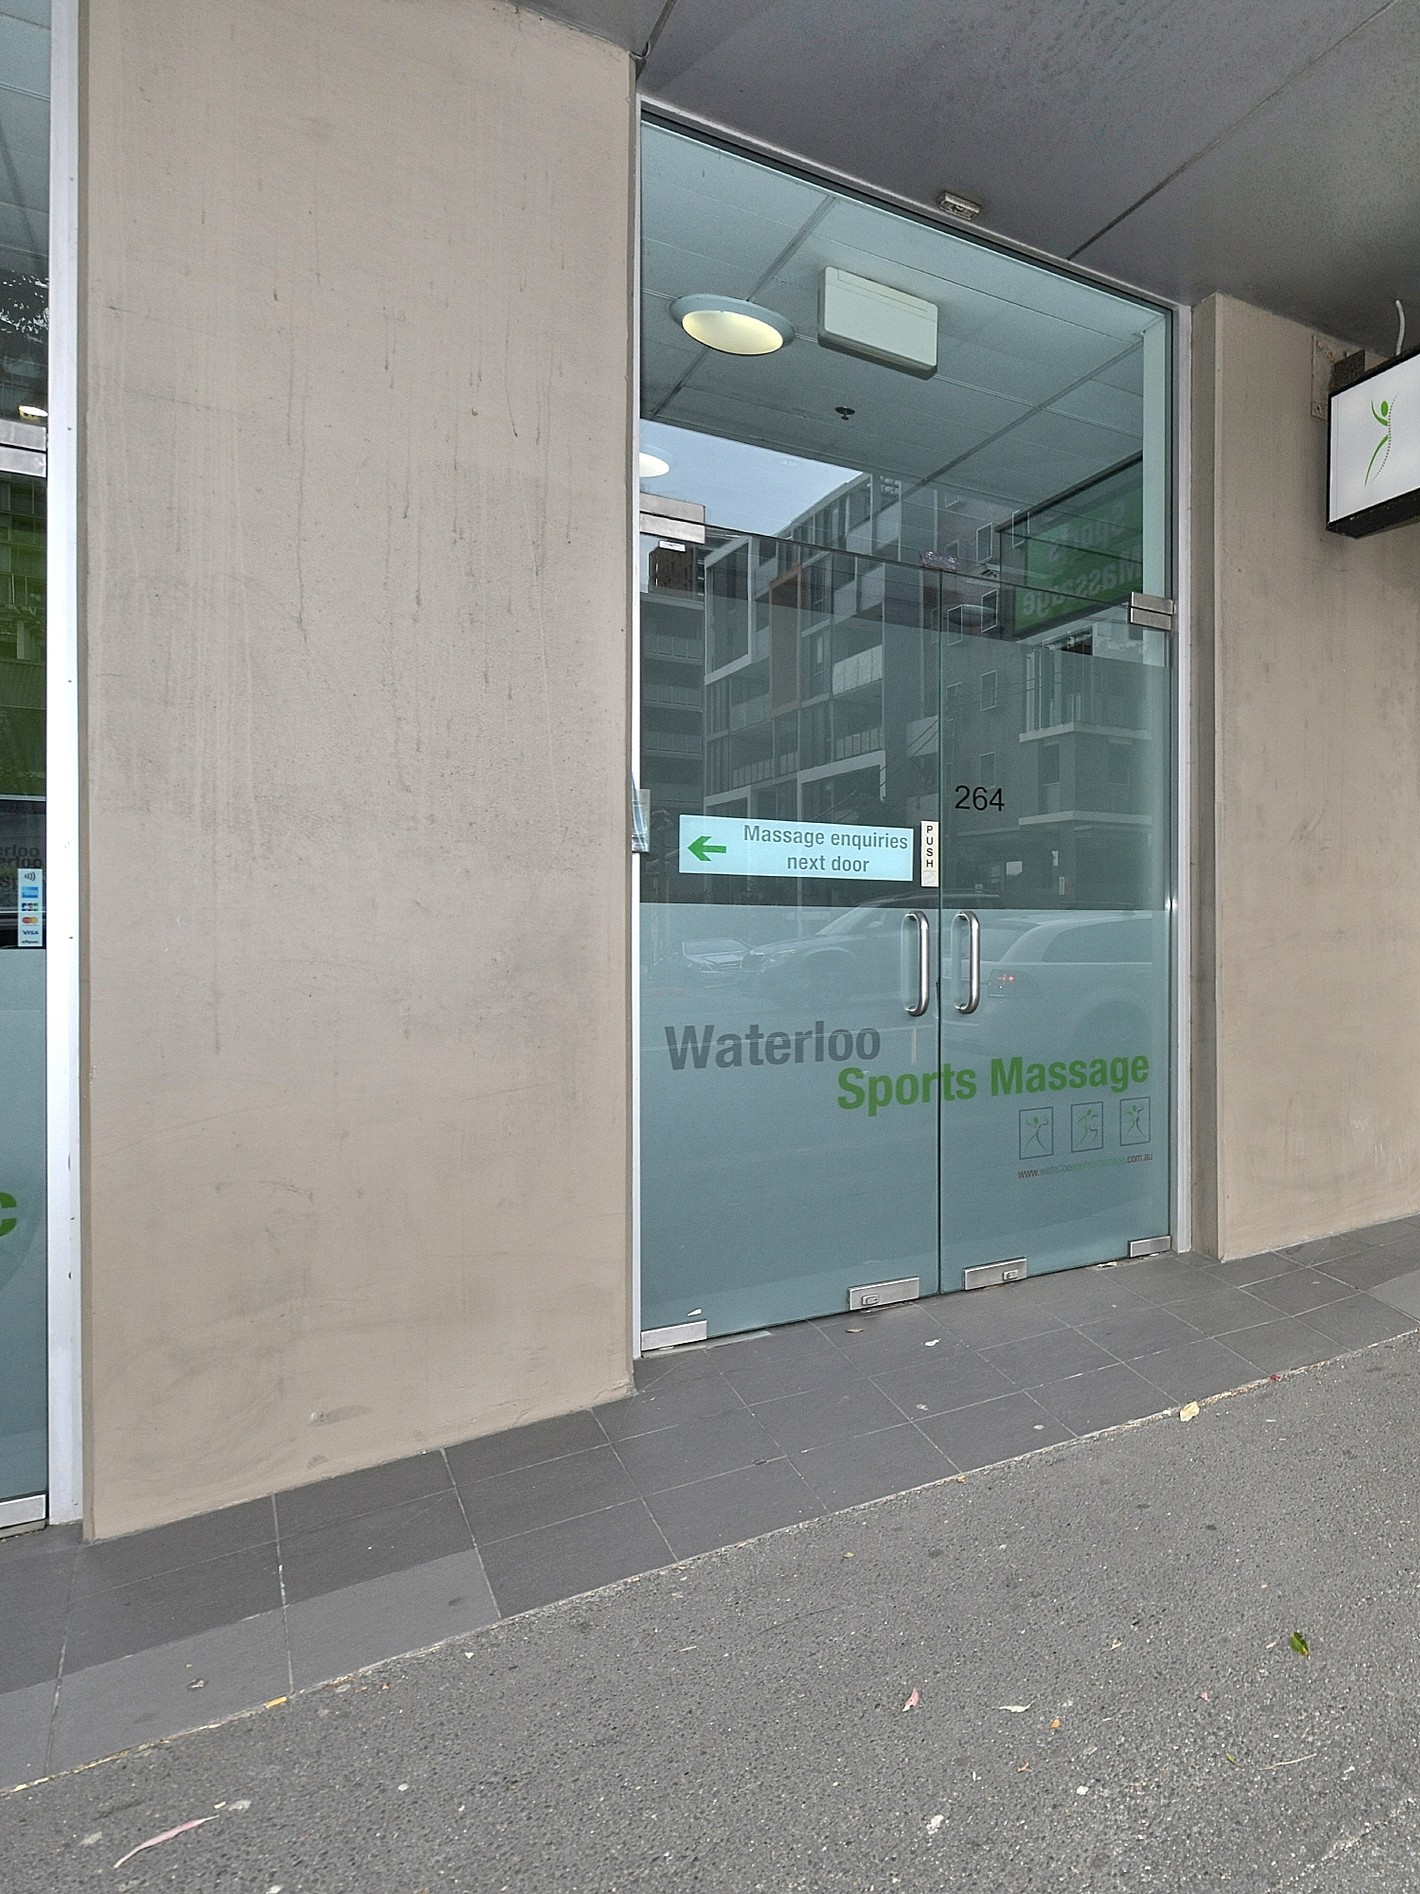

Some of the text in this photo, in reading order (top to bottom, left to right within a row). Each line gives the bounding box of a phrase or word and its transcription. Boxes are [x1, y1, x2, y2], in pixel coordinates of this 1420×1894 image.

[955, 785, 1005, 812] 264
[743, 824, 909, 851] Massage enquiries
[926, 825, 934, 868] PUSH
[787, 855, 870, 872] next door
[664, 1020, 881, 1070] Waterloo
[837, 1054, 1150, 1117] Sports Massage
